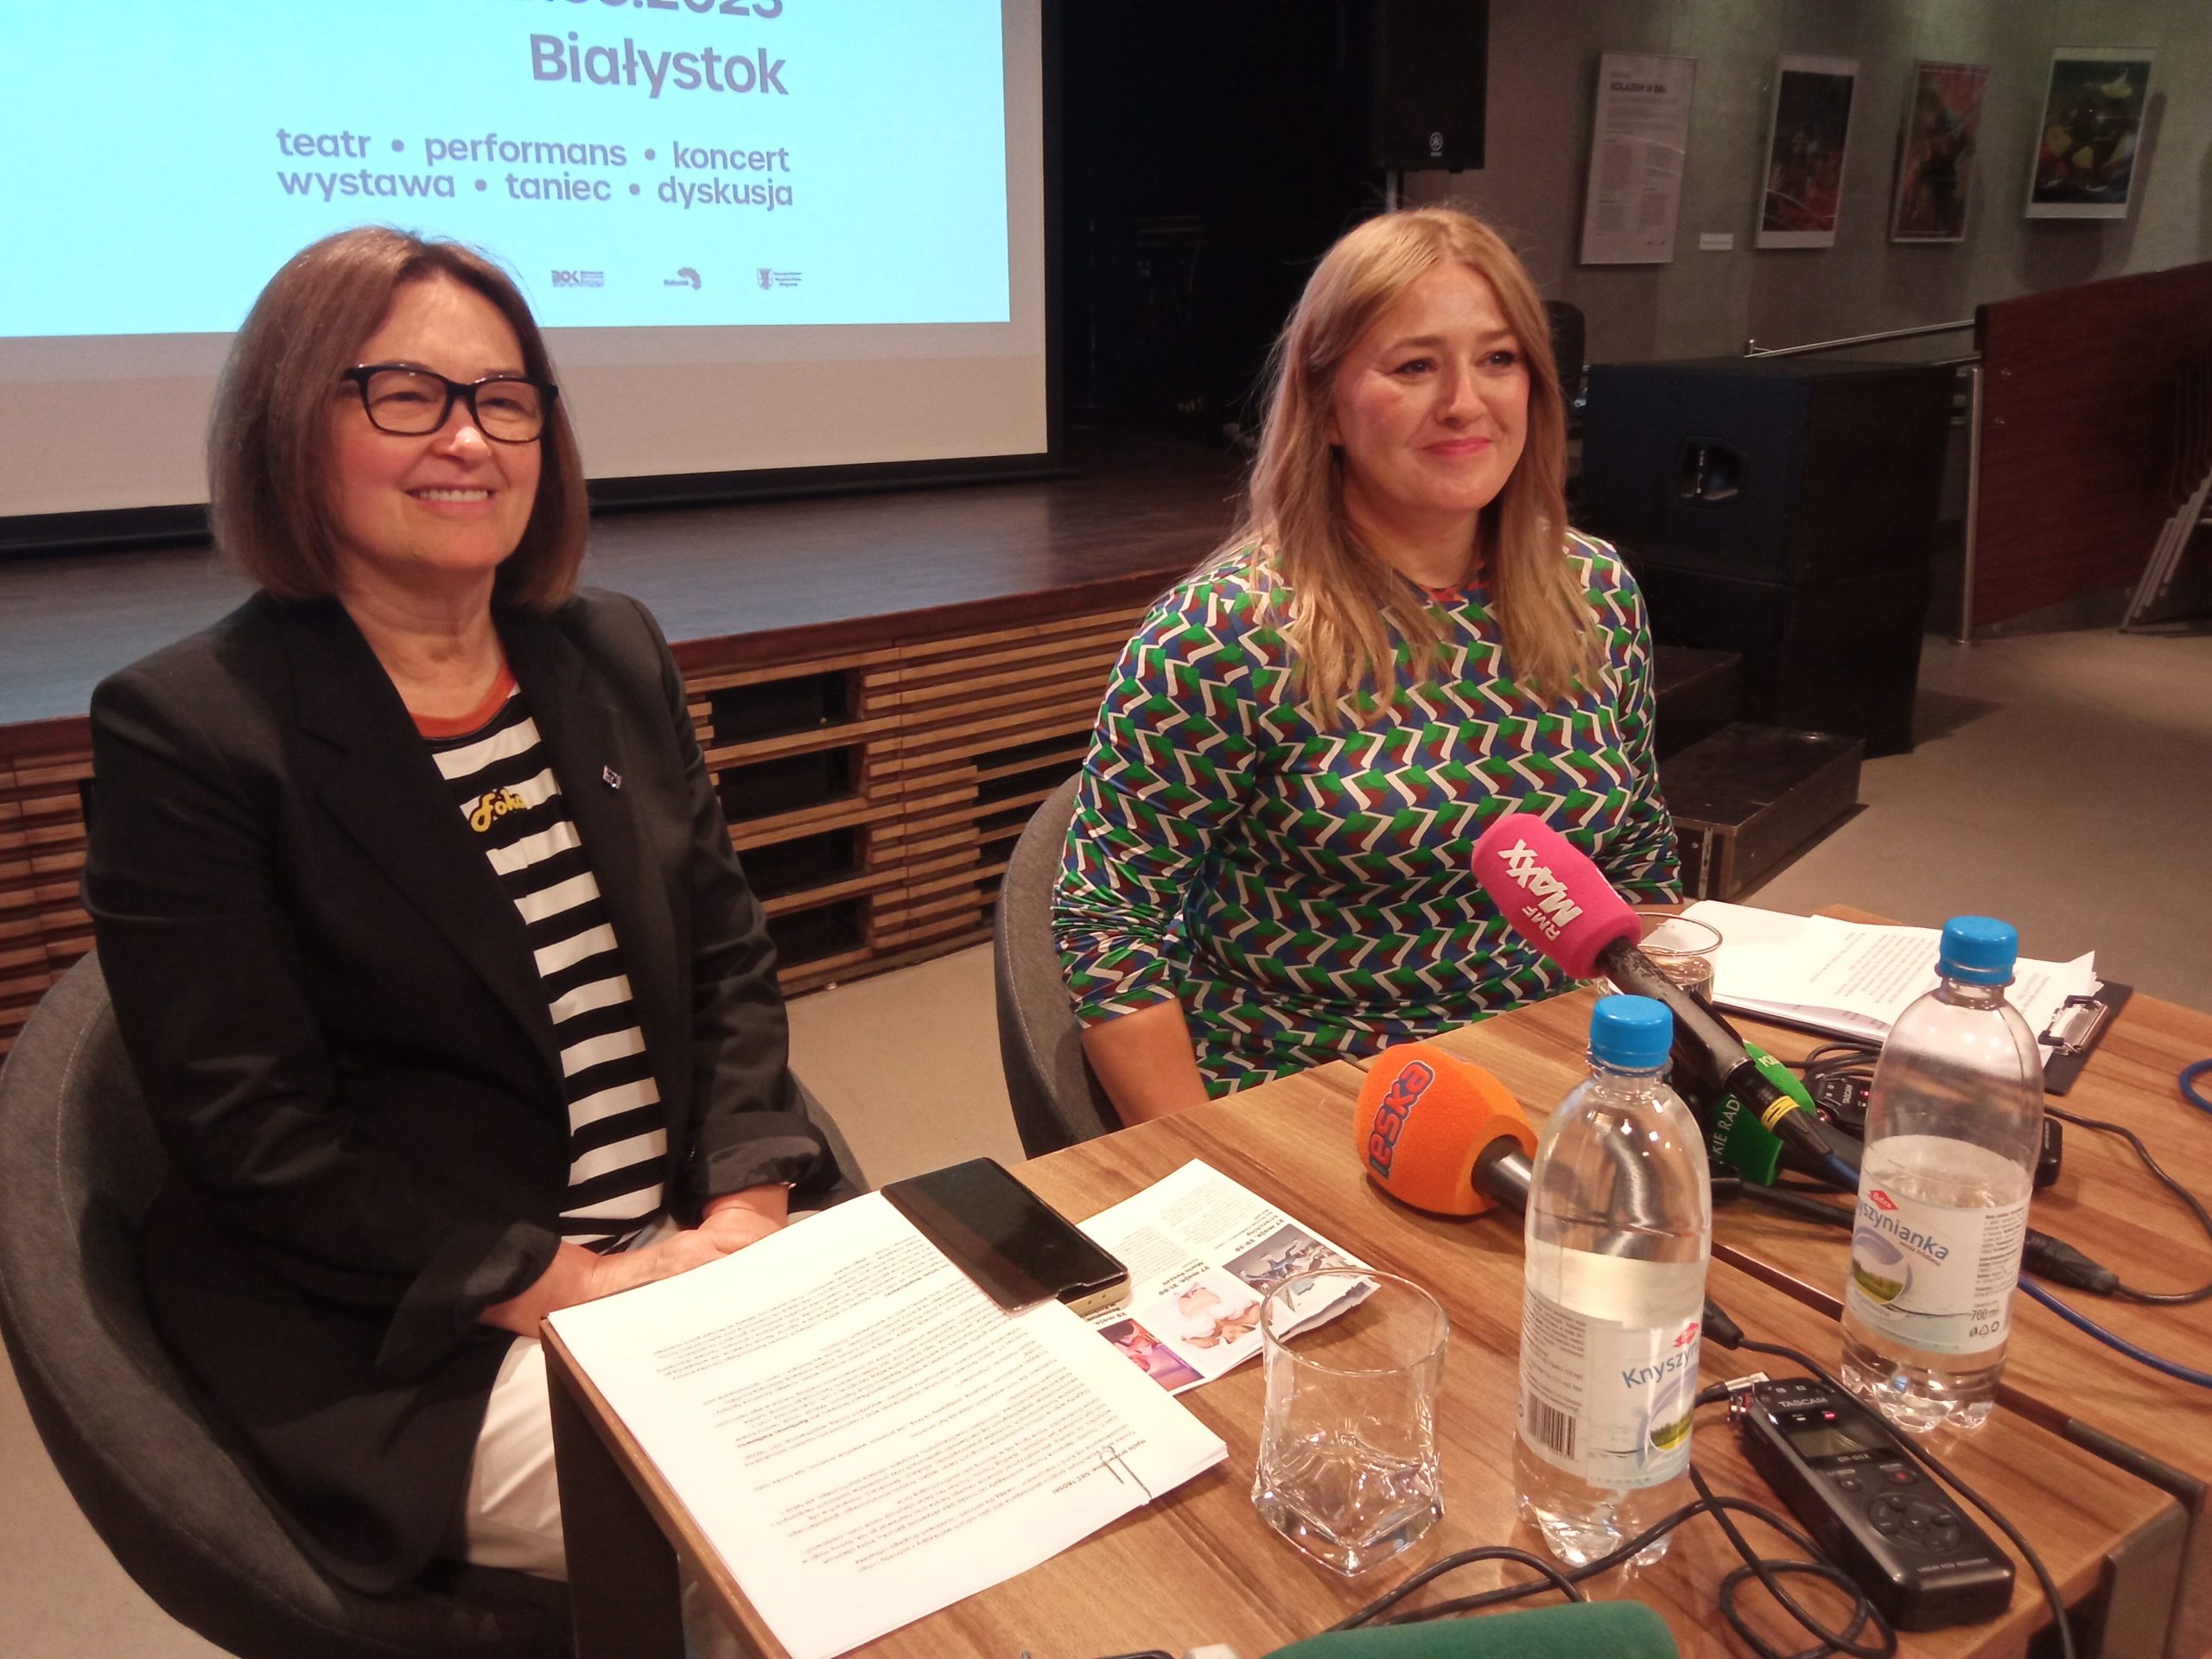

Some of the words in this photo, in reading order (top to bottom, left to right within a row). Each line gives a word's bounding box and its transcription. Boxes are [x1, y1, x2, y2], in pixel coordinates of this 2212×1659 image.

[530, 31, 789, 99] Białystok
[276, 129, 371, 158] teatr
[424, 133, 627, 167] performans
[673, 141, 790, 172] koncert
[277, 169, 455, 202] wystawa
[505, 172, 612, 200] taniec
[658, 175, 792, 212] dyskusja
[1497, 838, 1583, 928] MAXX
[1522, 906, 1560, 941] RMF
[1778, 1396, 1827, 1408] TASCAM
